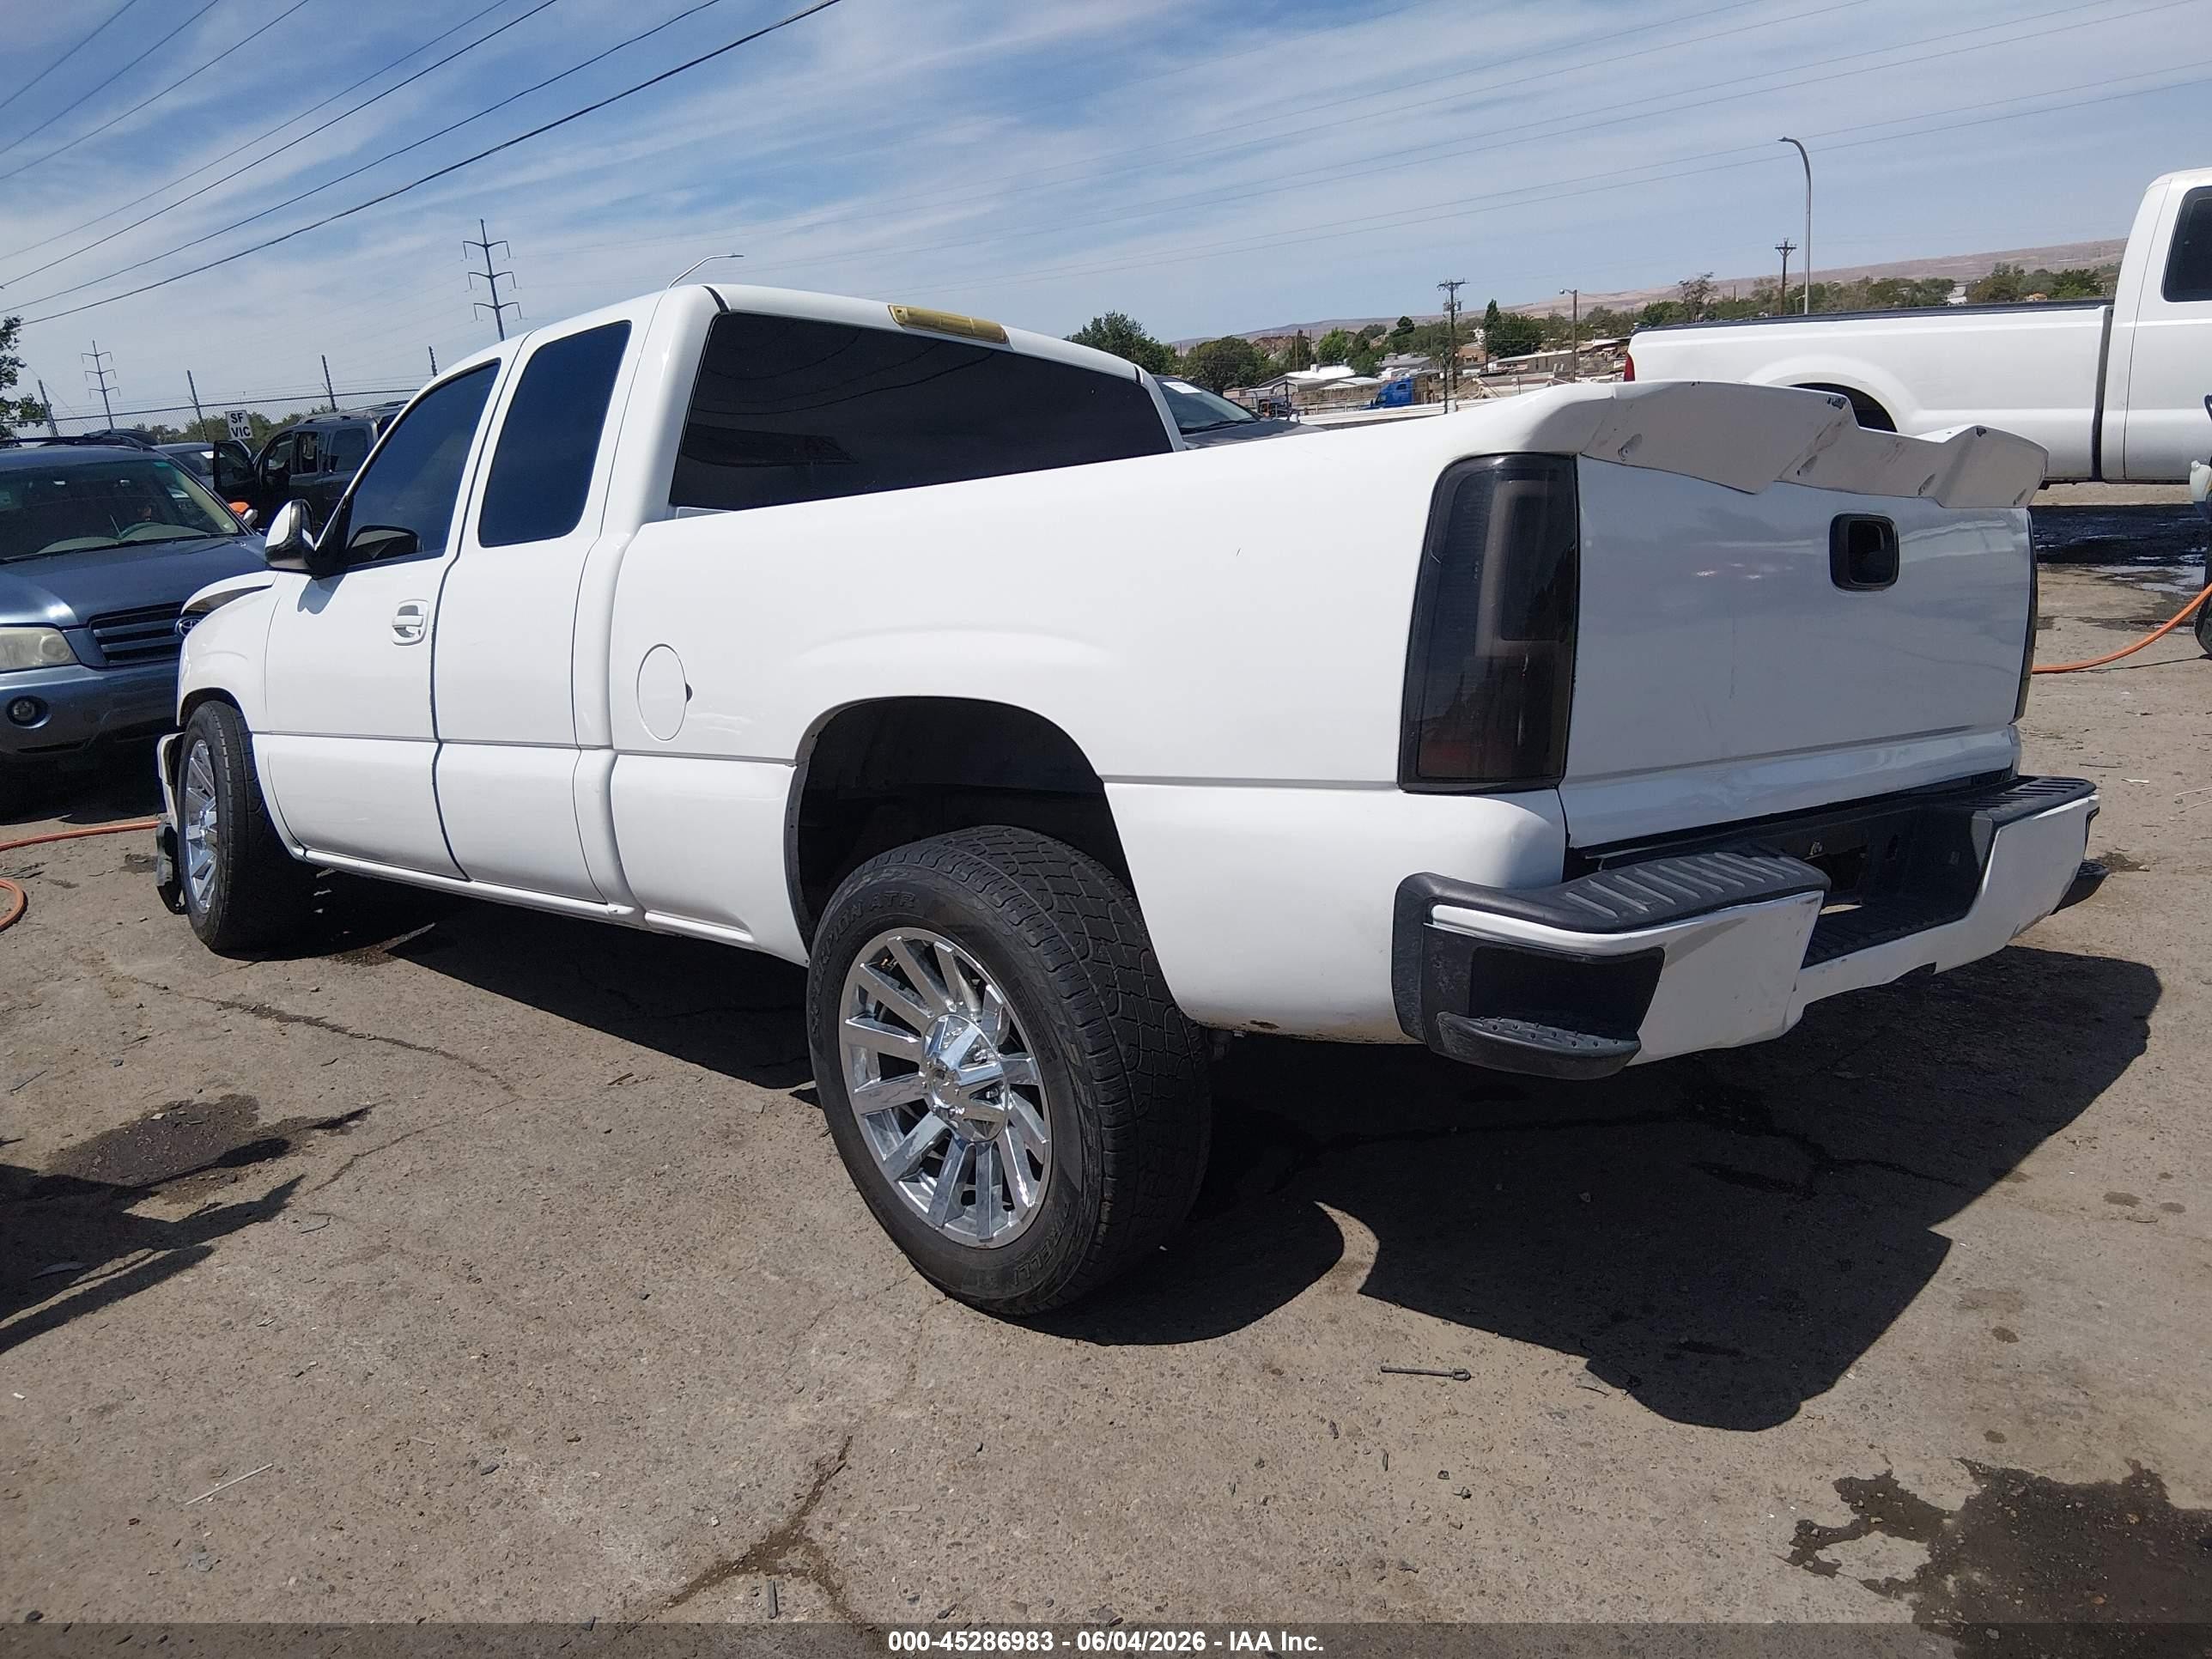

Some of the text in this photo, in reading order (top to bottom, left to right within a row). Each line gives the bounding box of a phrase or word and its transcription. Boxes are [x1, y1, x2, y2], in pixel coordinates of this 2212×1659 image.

[230, 412, 243, 423] SF
[231, 426, 251, 437] VIC
[869, 890, 916, 910] ATR
